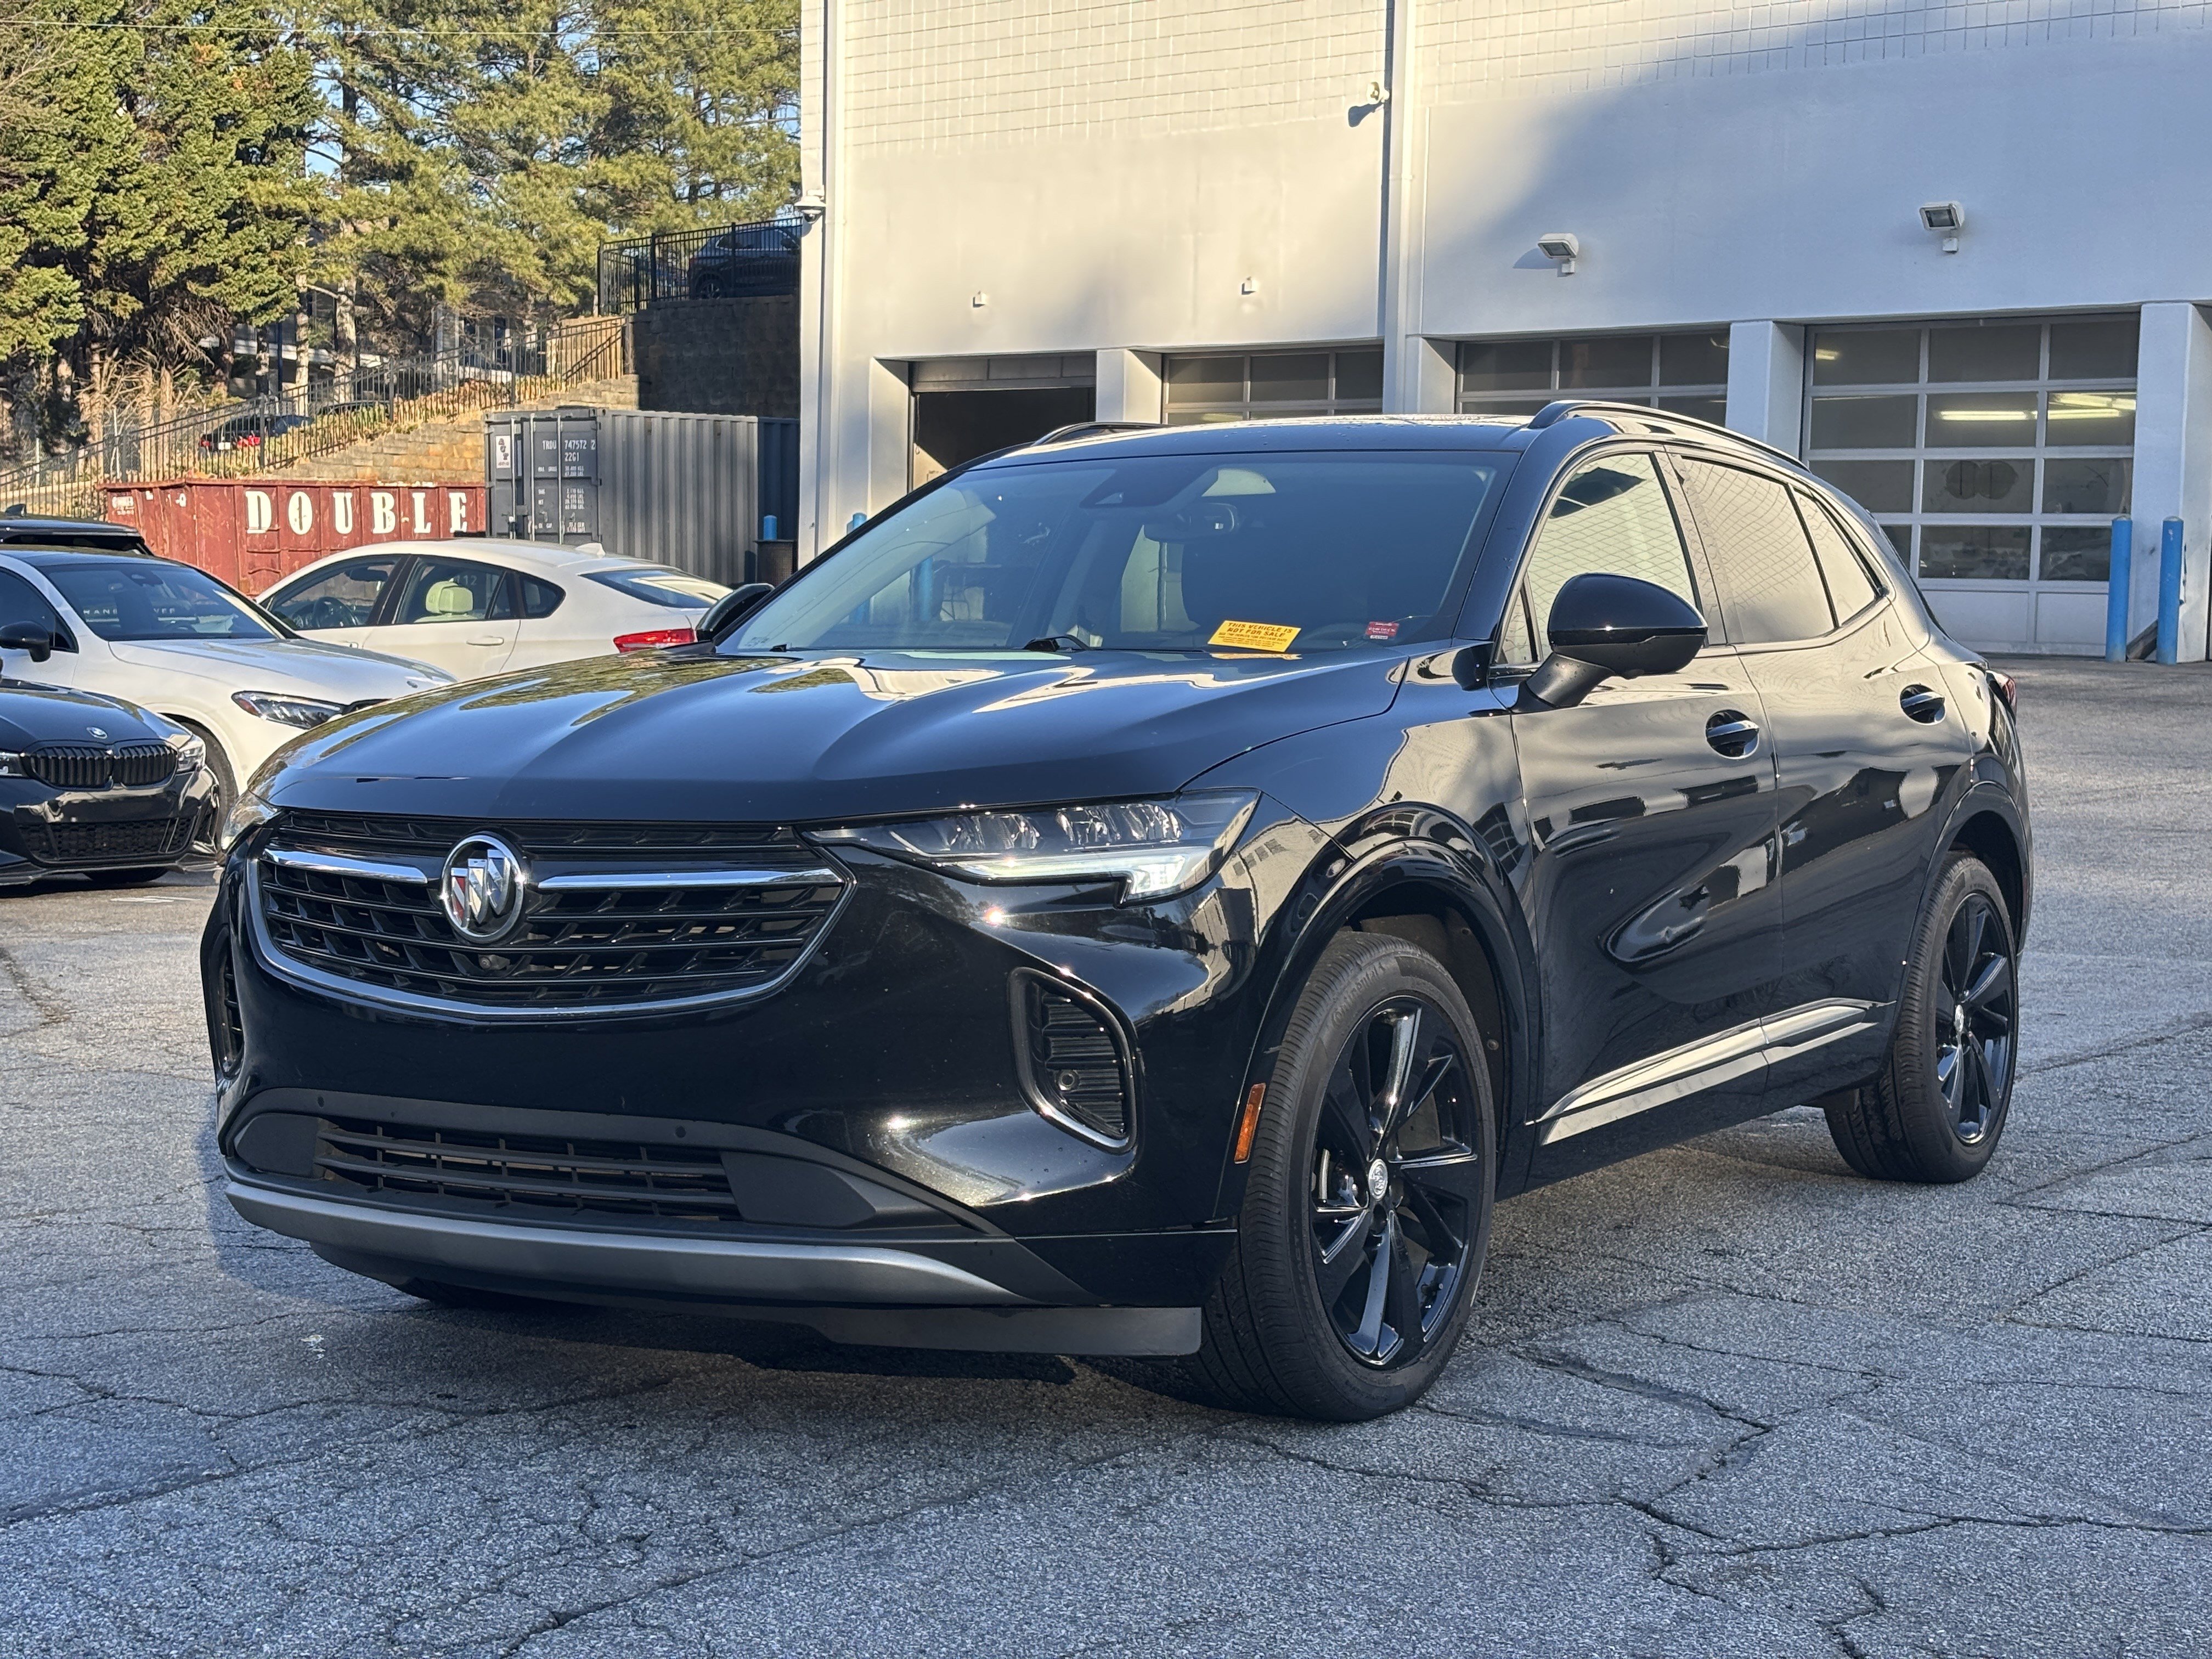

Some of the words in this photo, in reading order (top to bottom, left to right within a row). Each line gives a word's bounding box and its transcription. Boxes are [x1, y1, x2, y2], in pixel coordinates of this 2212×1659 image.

[591, 439, 596, 450] 2
[565, 452, 579, 461] 22G1
[245, 491, 467, 535] DOUBLE
